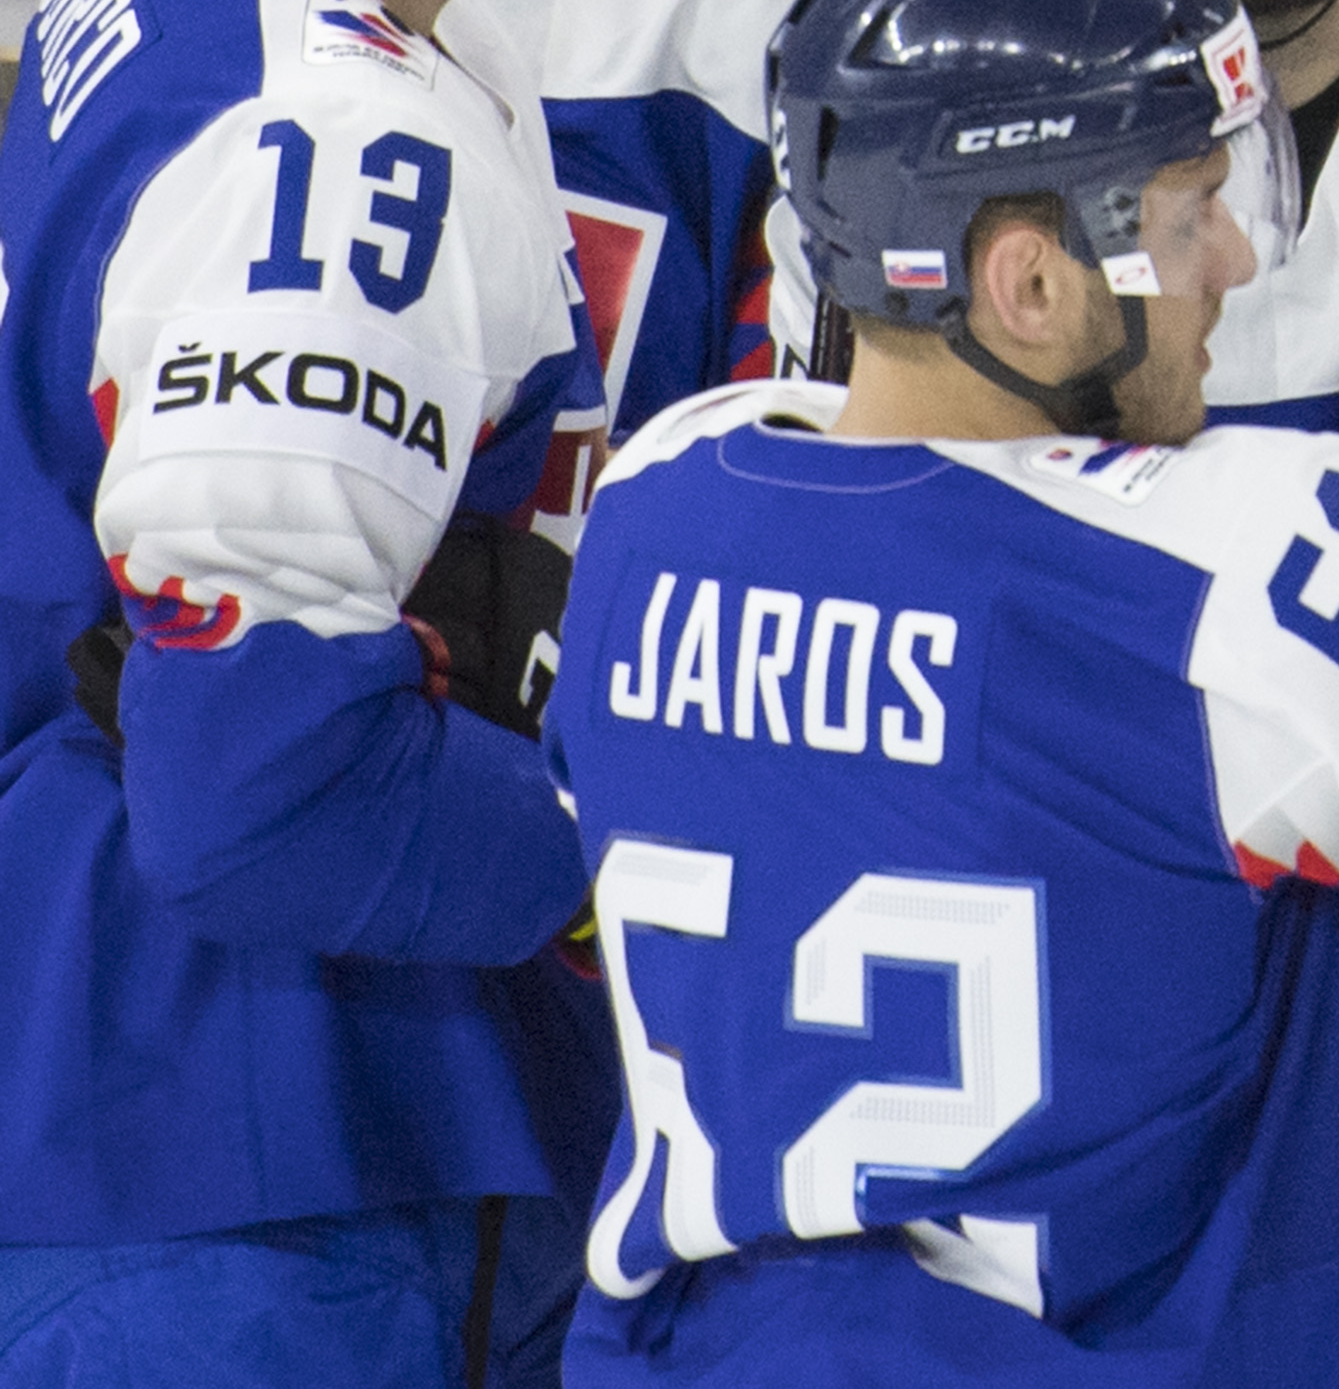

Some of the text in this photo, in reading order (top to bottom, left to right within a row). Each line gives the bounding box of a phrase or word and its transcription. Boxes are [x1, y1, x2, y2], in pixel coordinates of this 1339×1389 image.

[956, 114, 1076, 155] CCM
[247, 118, 452, 315] 13
[152, 342, 448, 473] ŠKODA
[610, 571, 958, 767] JAROS
